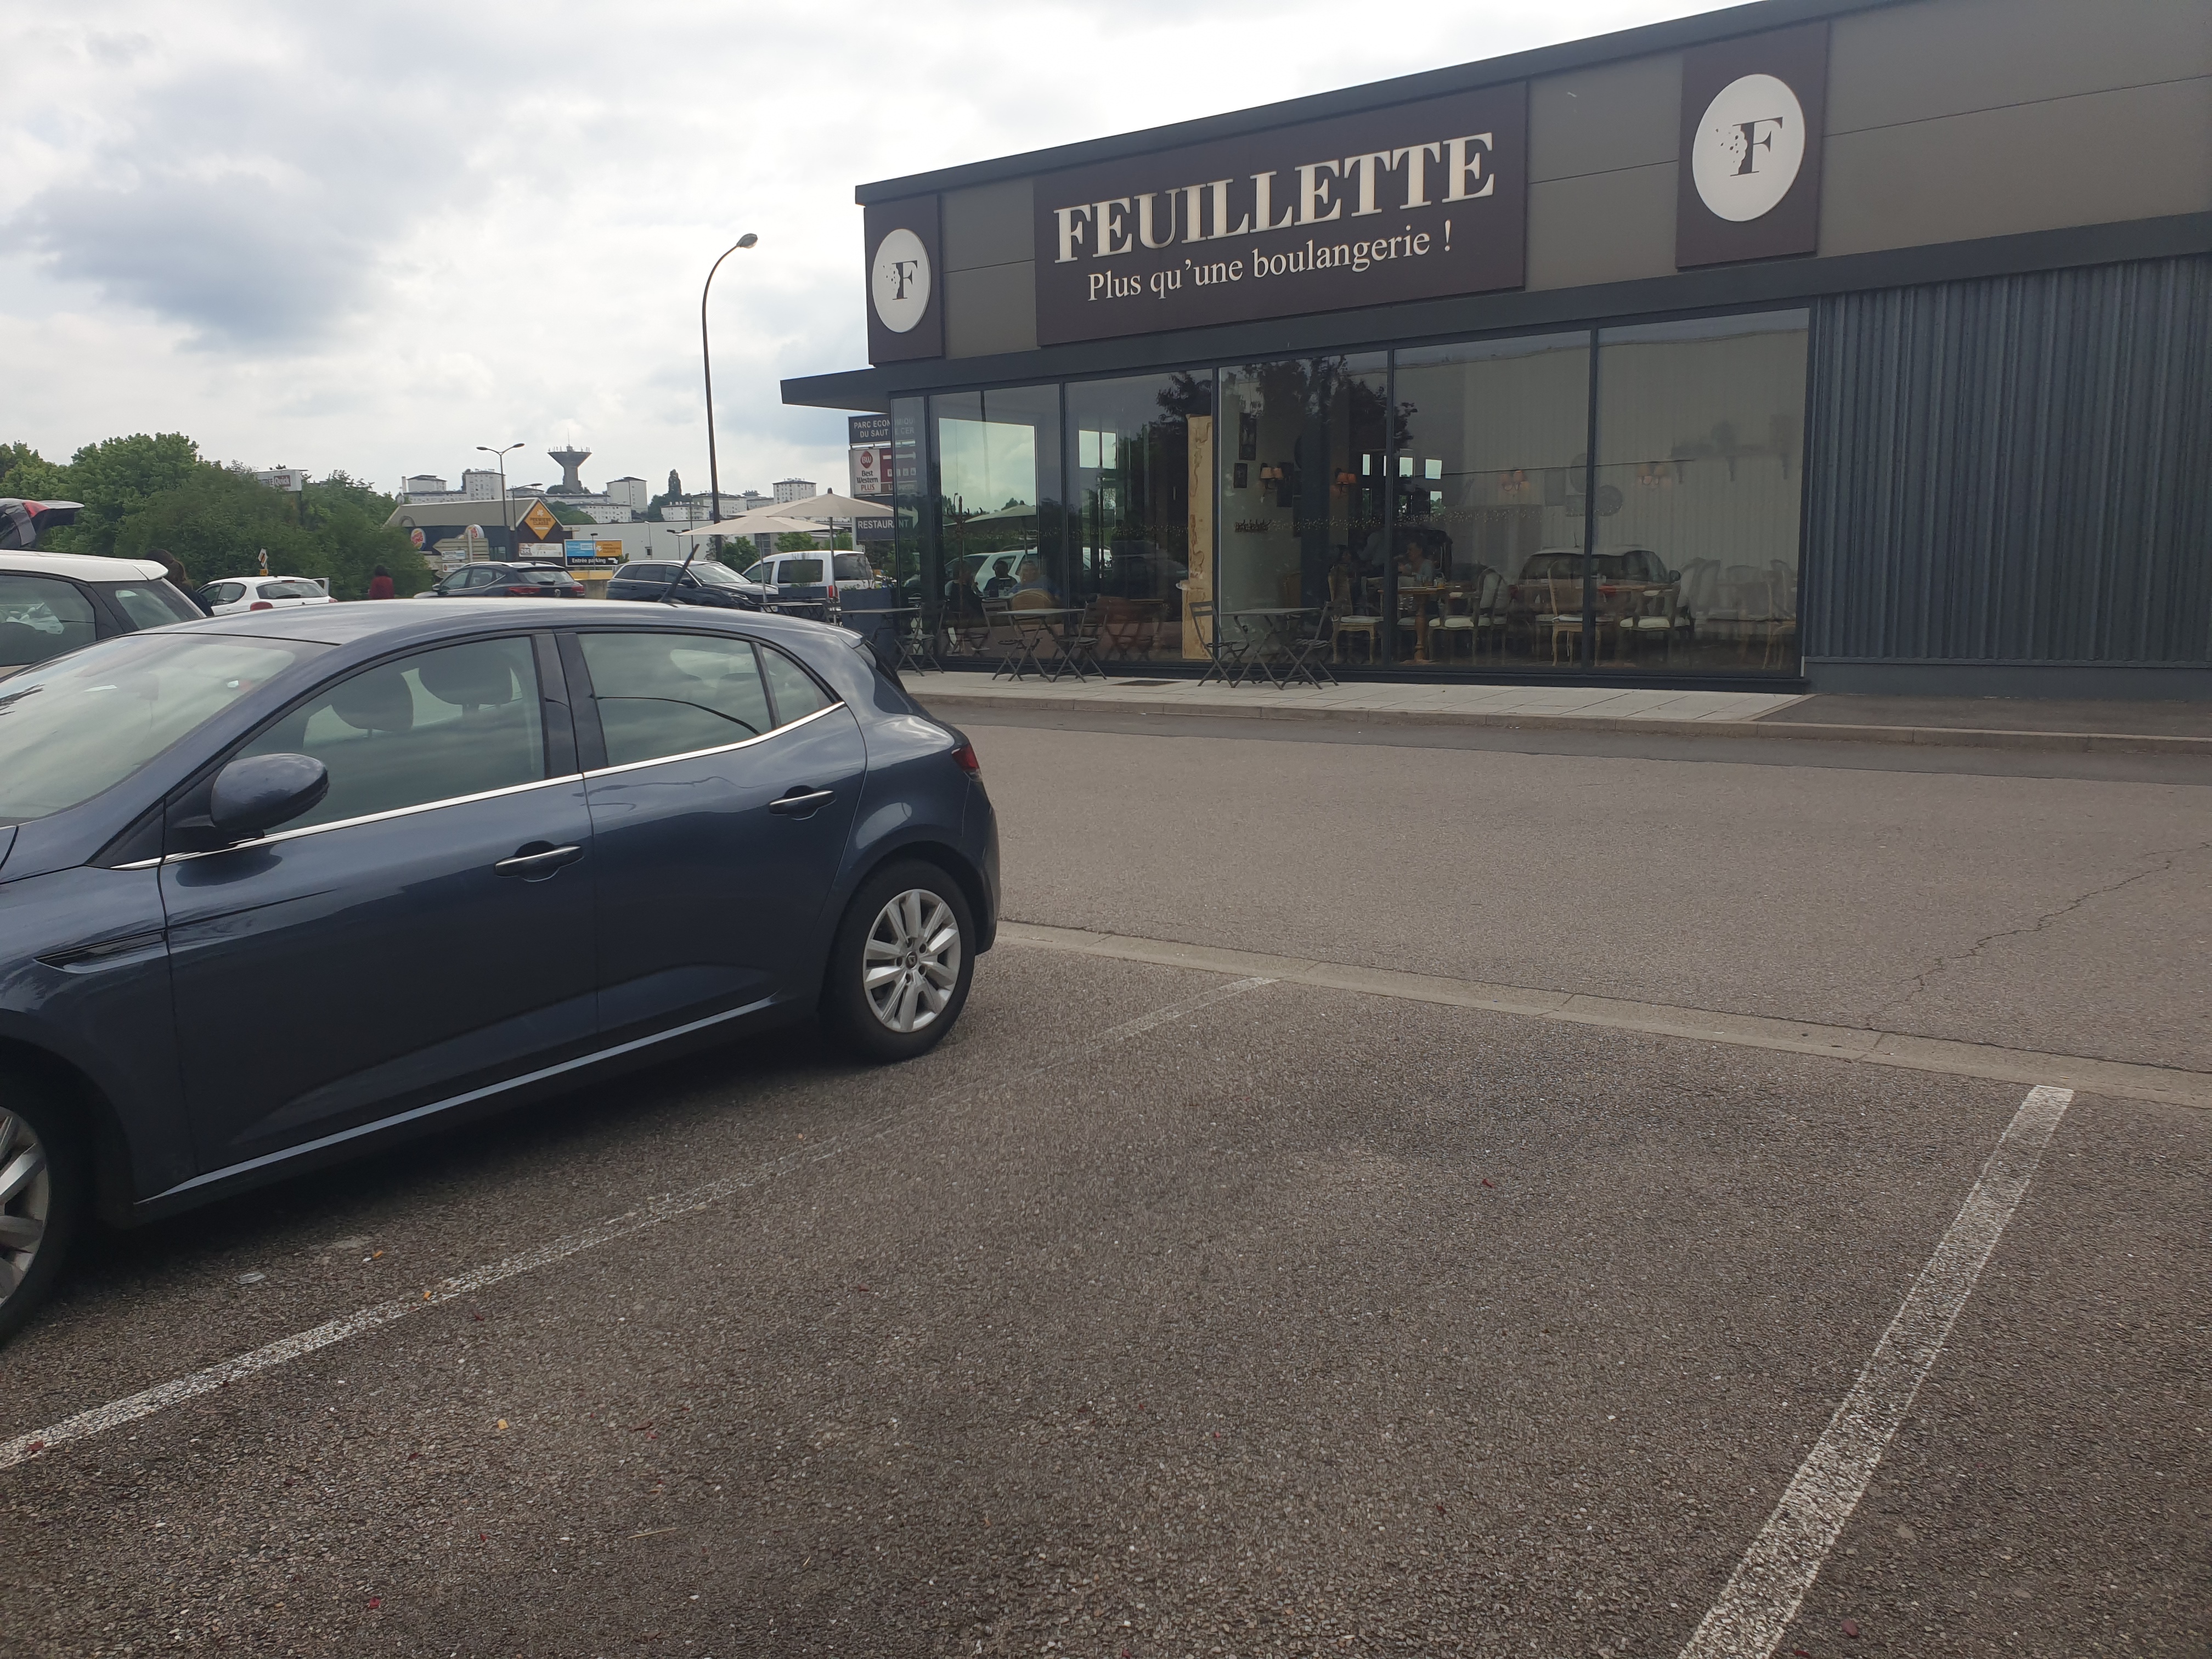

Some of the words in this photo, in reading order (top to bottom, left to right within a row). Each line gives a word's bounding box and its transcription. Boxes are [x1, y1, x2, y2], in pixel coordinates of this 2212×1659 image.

[1730, 116, 1784, 177] F
[1053, 132, 1496, 264] FEUILLETTE
[891, 259, 918, 301] F
[1088, 270, 1141, 301] Plus
[1150, 258, 1243, 300] qu'une
[1251, 223, 1430, 279] boulangerie
[854, 421, 871, 429] PARC
[873, 417, 915, 427] ECONMIQU
[871, 428, 888, 437] SAUT
[858, 519, 909, 529] RESTAURNT
